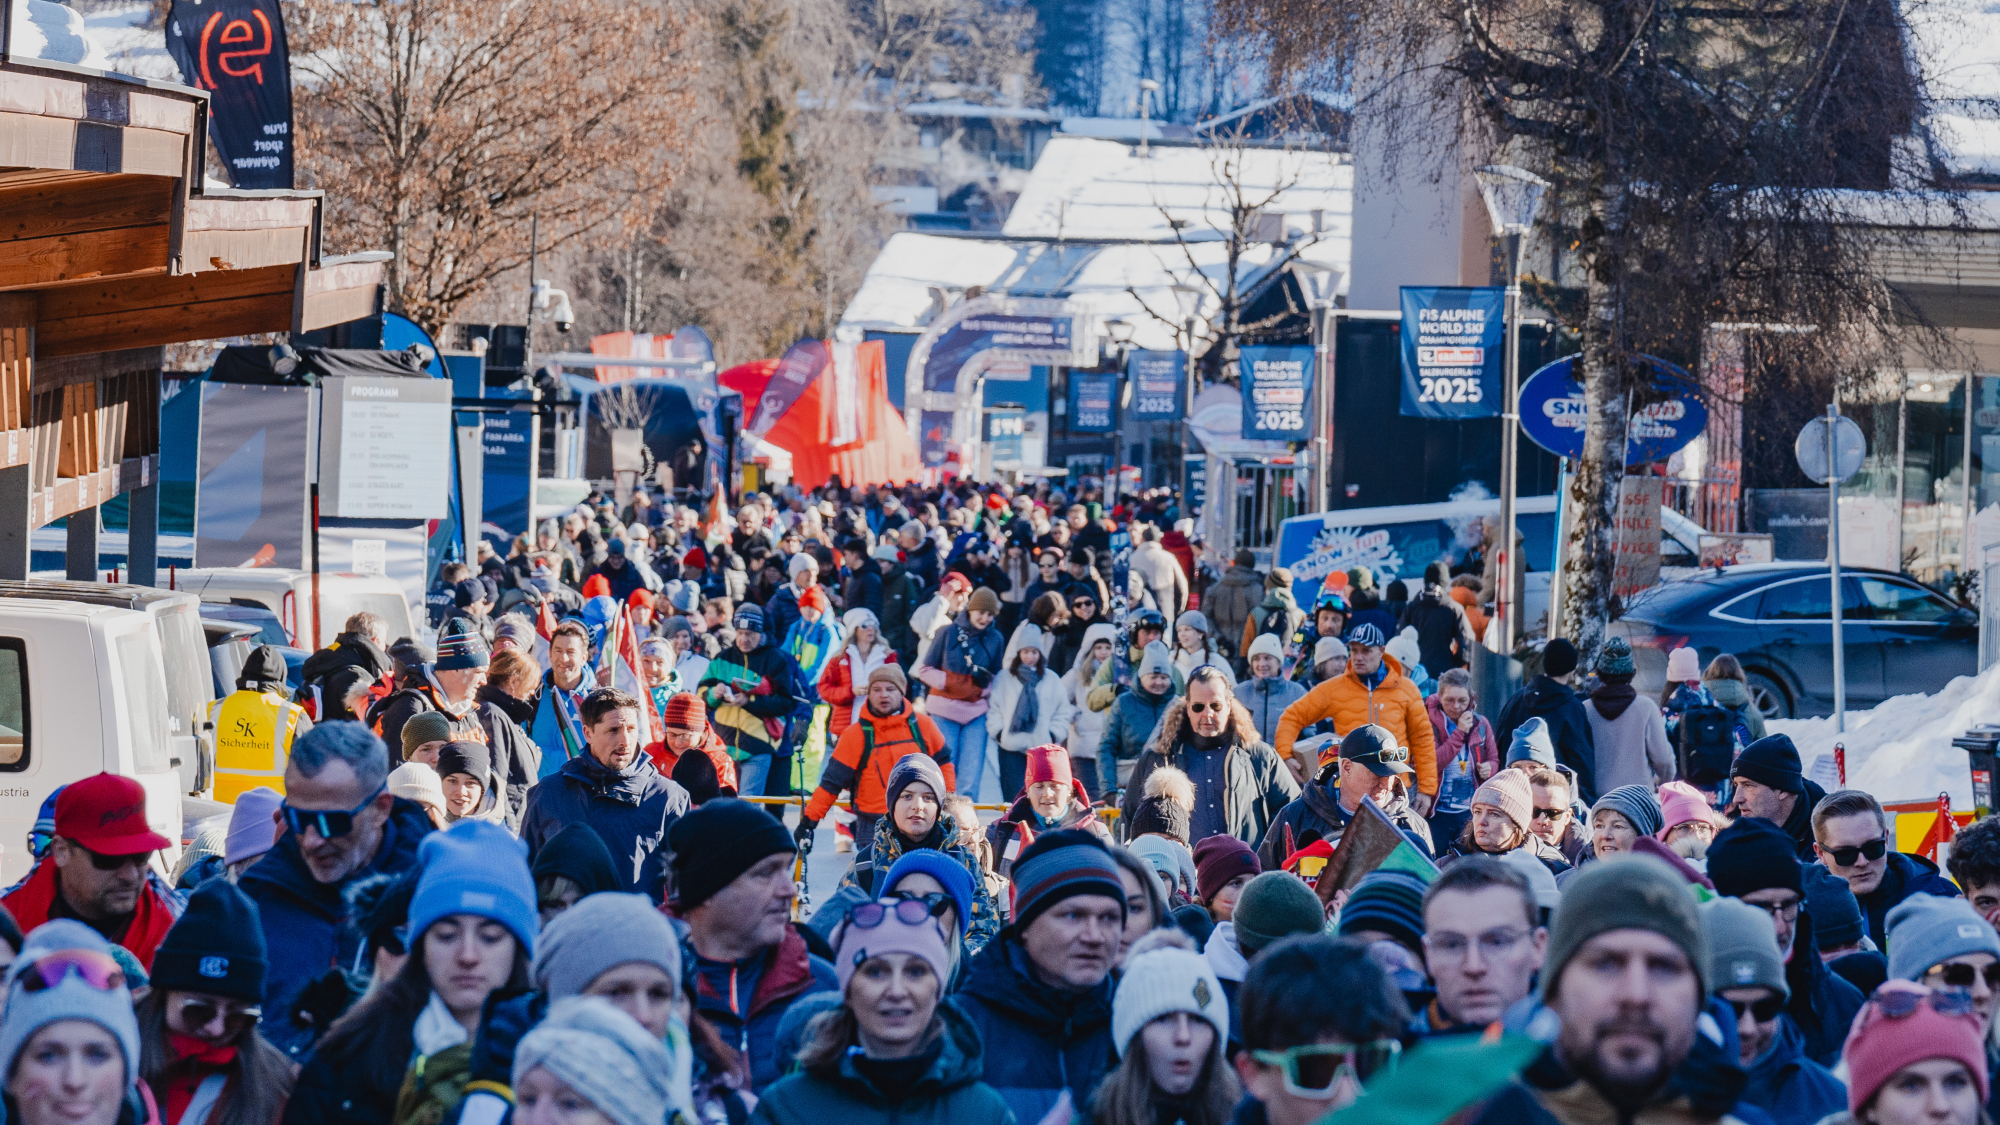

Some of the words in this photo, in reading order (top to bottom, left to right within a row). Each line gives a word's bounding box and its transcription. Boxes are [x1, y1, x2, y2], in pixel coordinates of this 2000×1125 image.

[1419, 309, 1439, 321] FIS
[1440, 309, 1485, 322] ALPINE
[1419, 322, 1464, 335] WORLD
[1465, 322, 1485, 334] SKI
[1418, 335, 1483, 345] CHAMPIONSHIPS
[351, 386, 399, 398] PROGRAMM
[1418, 377, 1484, 403] 2025
[1138, 398, 1175, 412] 2025
[485, 418, 511, 429] STAGE
[1255, 411, 1304, 430] 2025
[1297, 549, 1343, 573] SNOW
[1355, 533, 1383, 550] fun
[234, 717, 258, 737] SK
[220, 737, 270, 750] Sicherheit
